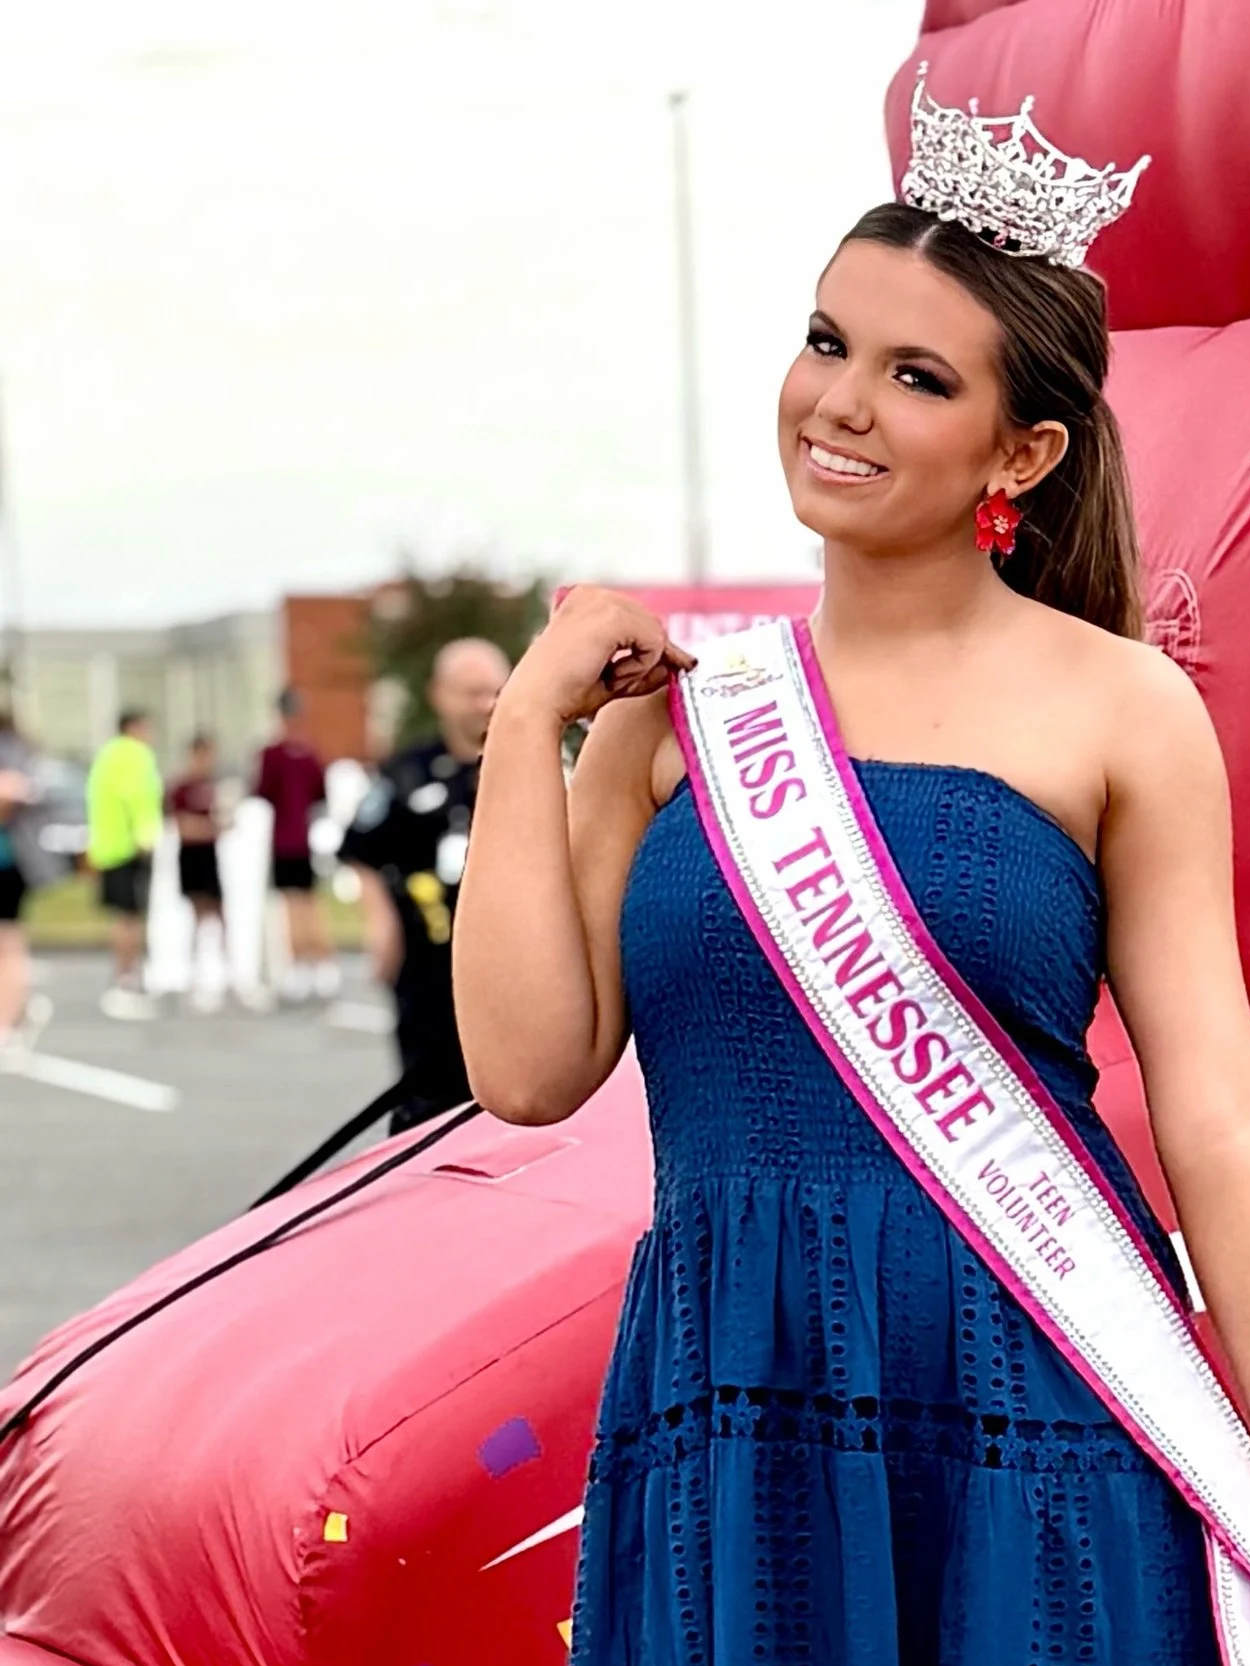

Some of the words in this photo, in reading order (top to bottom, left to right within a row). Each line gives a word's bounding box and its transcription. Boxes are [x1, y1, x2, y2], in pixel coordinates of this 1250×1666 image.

[723, 700, 807, 820] MISS
[773, 826, 996, 1143] TENNESSEE
[978, 1158, 1076, 1281] VOLUNTEER
[1029, 1170, 1076, 1227] TEEN
